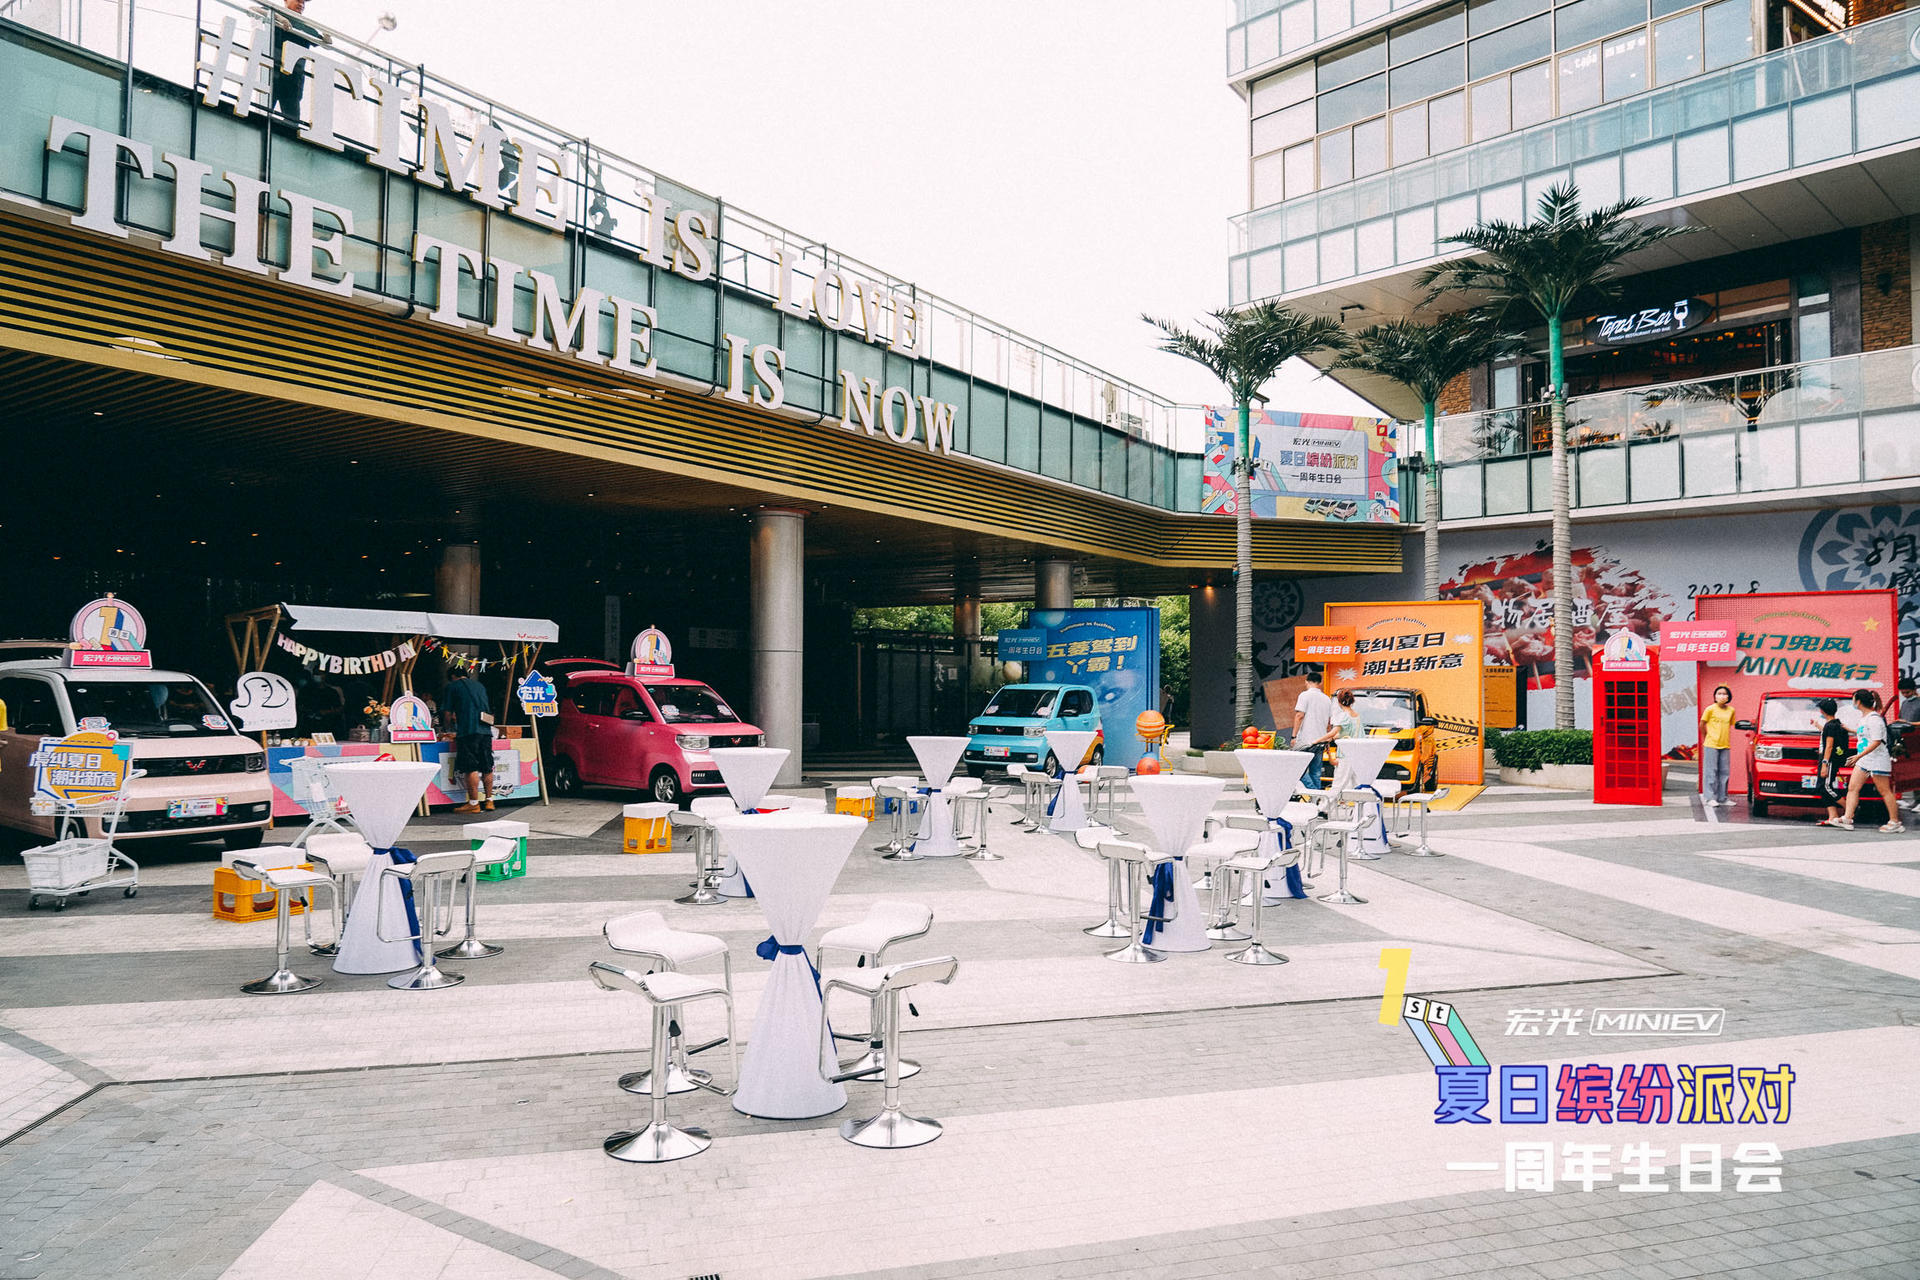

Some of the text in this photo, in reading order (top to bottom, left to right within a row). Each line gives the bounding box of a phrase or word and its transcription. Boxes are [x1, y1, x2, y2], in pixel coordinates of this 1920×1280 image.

[47, 115, 958, 455] THE TIME IS NOW
[639, 192, 712, 281] IS
[772, 248, 921, 360] LOVE
[1597, 308, 1672, 338] Tapas Bar
[1280, 450, 1359, 470] 夏日缤纷派对
[1291, 472, 1342, 484] 一周年生日会
[1047, 634, 1138, 658] 五菱驾到
[1299, 645, 1350, 655] 一周年生日会
[1665, 642, 1730, 653] 一周年生日会
[1362, 653, 1464, 677] 潮出新意
[531, 703, 554, 713] mini
[1438, 721, 1470, 733] WARNING
[50, 769, 118, 787] 潮出新意
